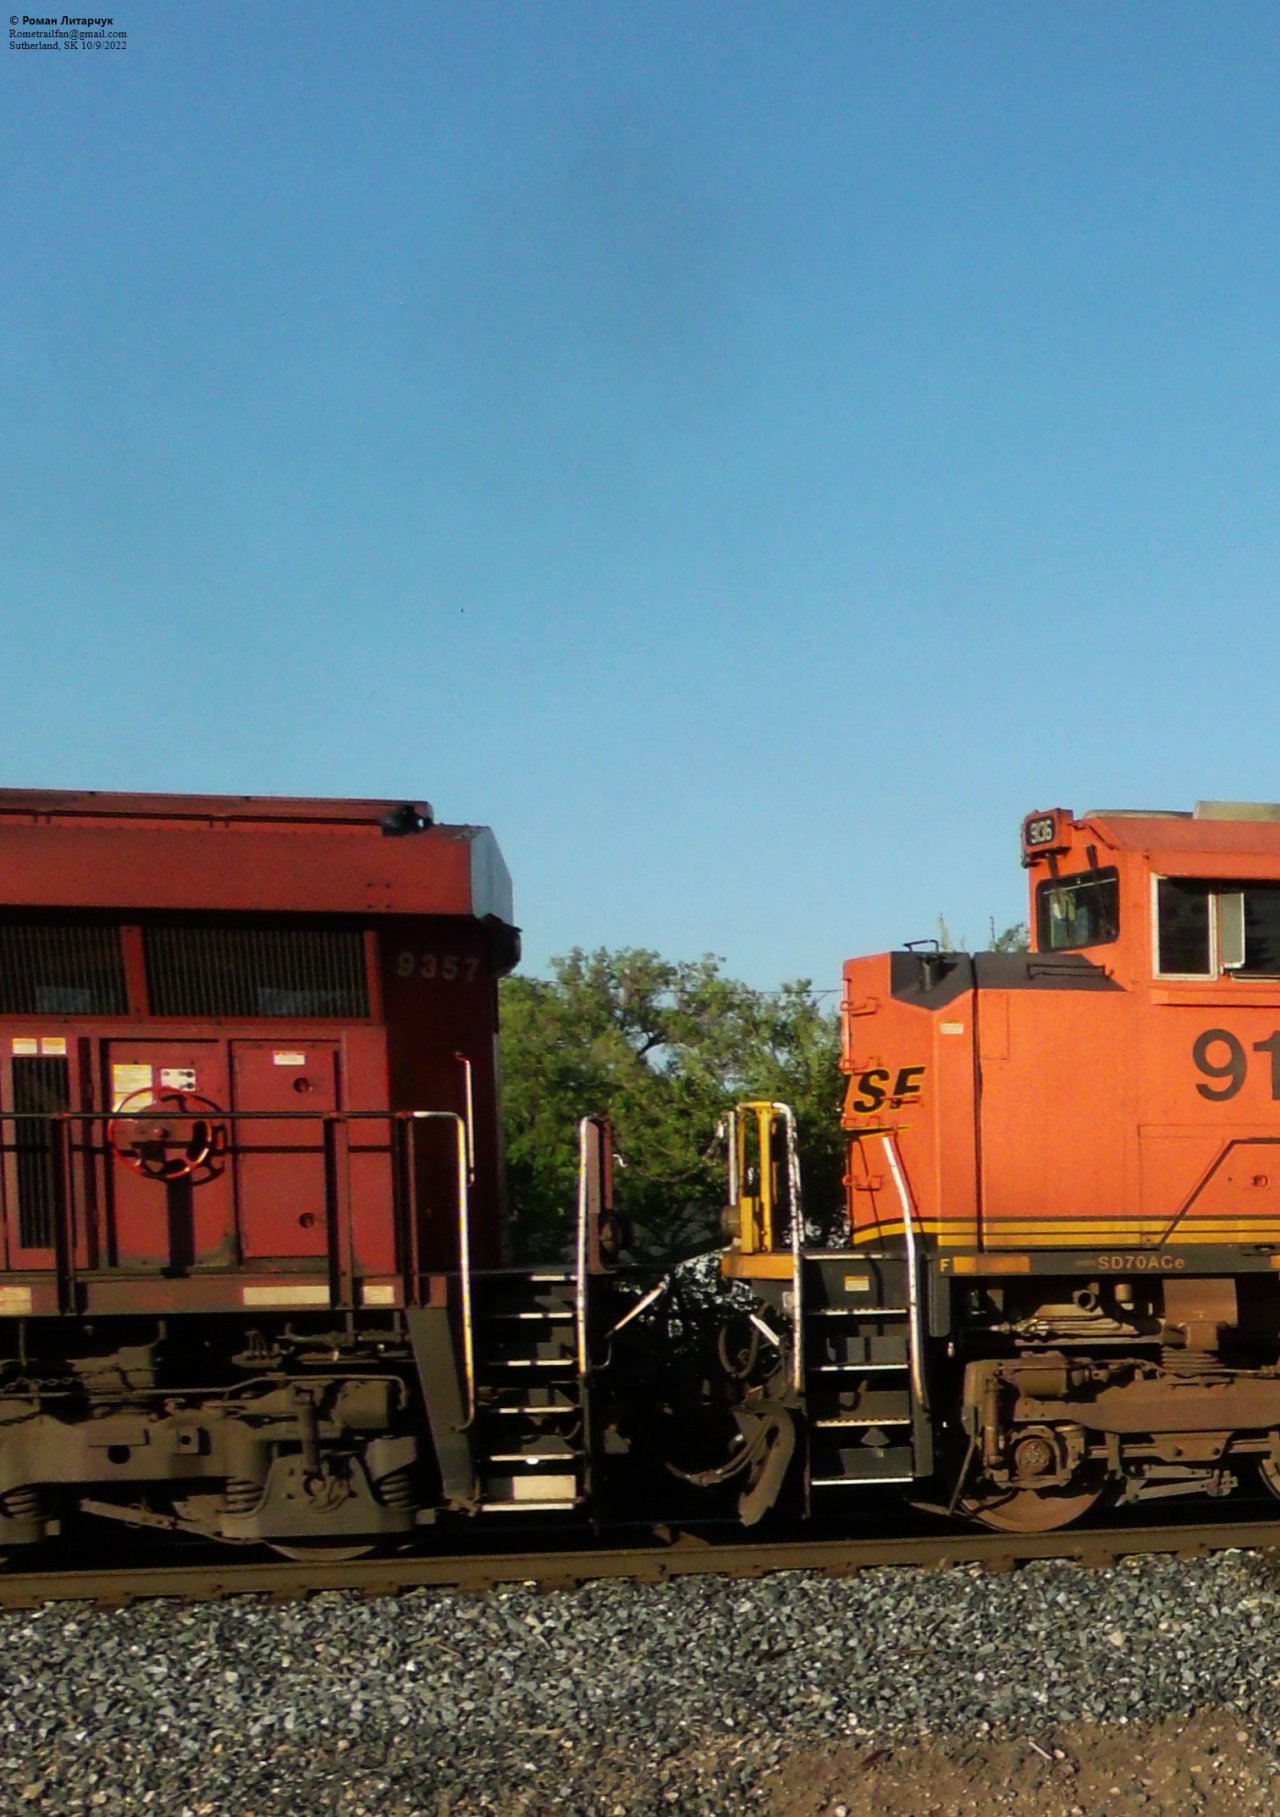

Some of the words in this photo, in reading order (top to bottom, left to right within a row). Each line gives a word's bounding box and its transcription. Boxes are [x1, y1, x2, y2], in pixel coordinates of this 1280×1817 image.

[397, 951, 480, 983] 9357
[940, 1258, 950, 1272] F
[1098, 1255, 1185, 1270] SD70ACe
